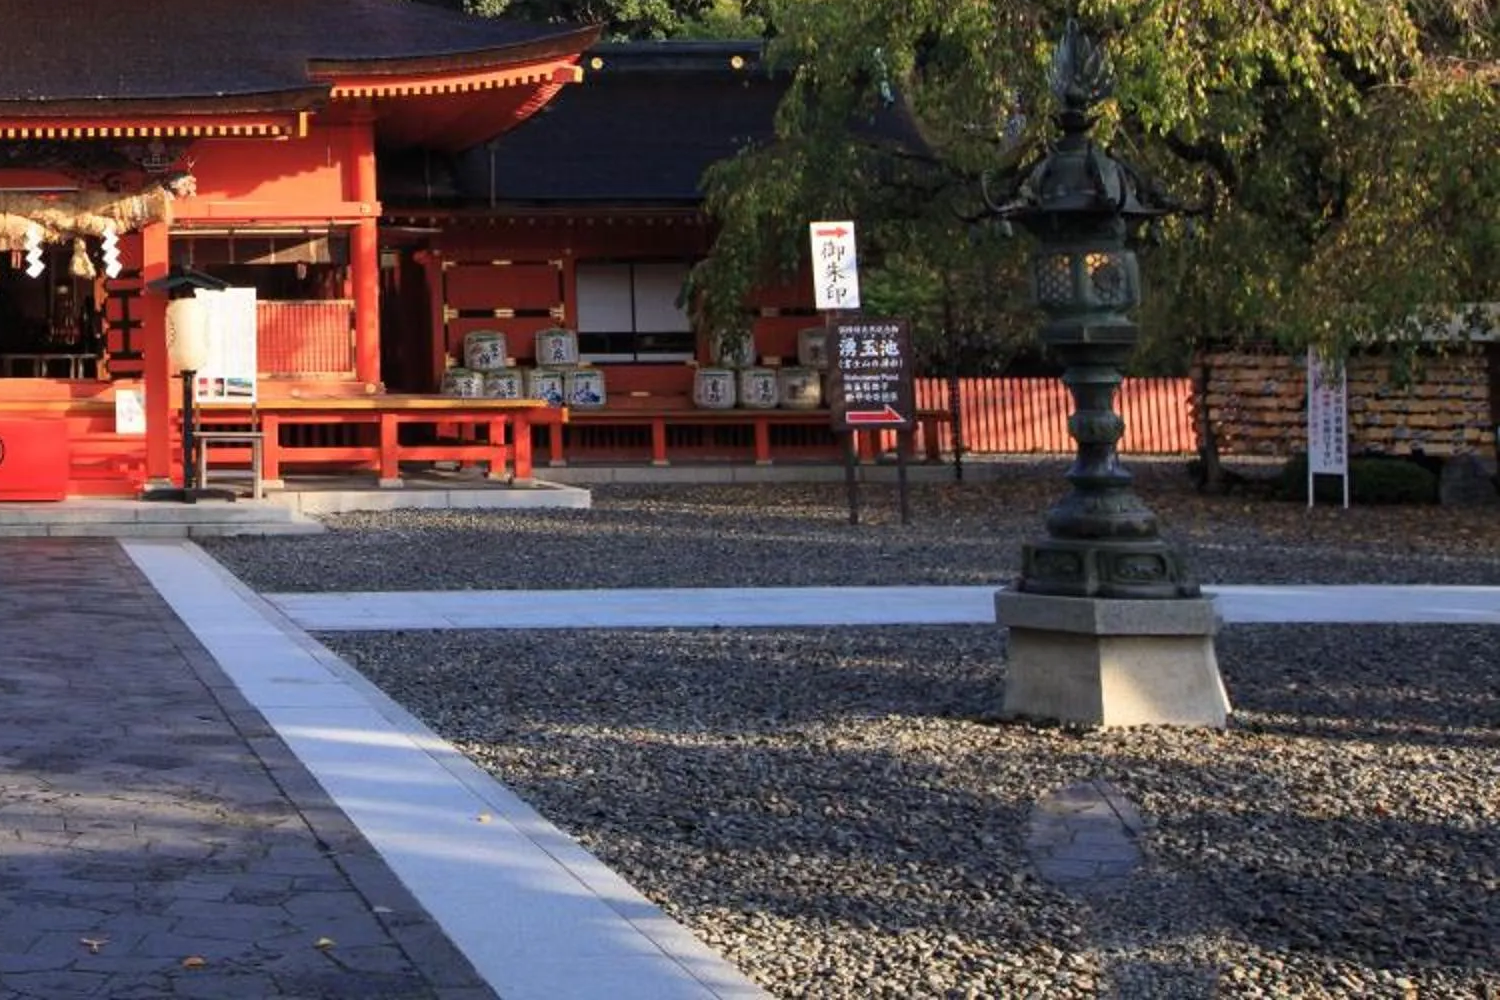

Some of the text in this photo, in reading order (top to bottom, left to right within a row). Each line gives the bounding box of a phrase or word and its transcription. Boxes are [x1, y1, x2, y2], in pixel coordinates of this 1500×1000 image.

[821, 240, 848, 304] 御朱印
[839, 338, 900, 357] 湧玉池
